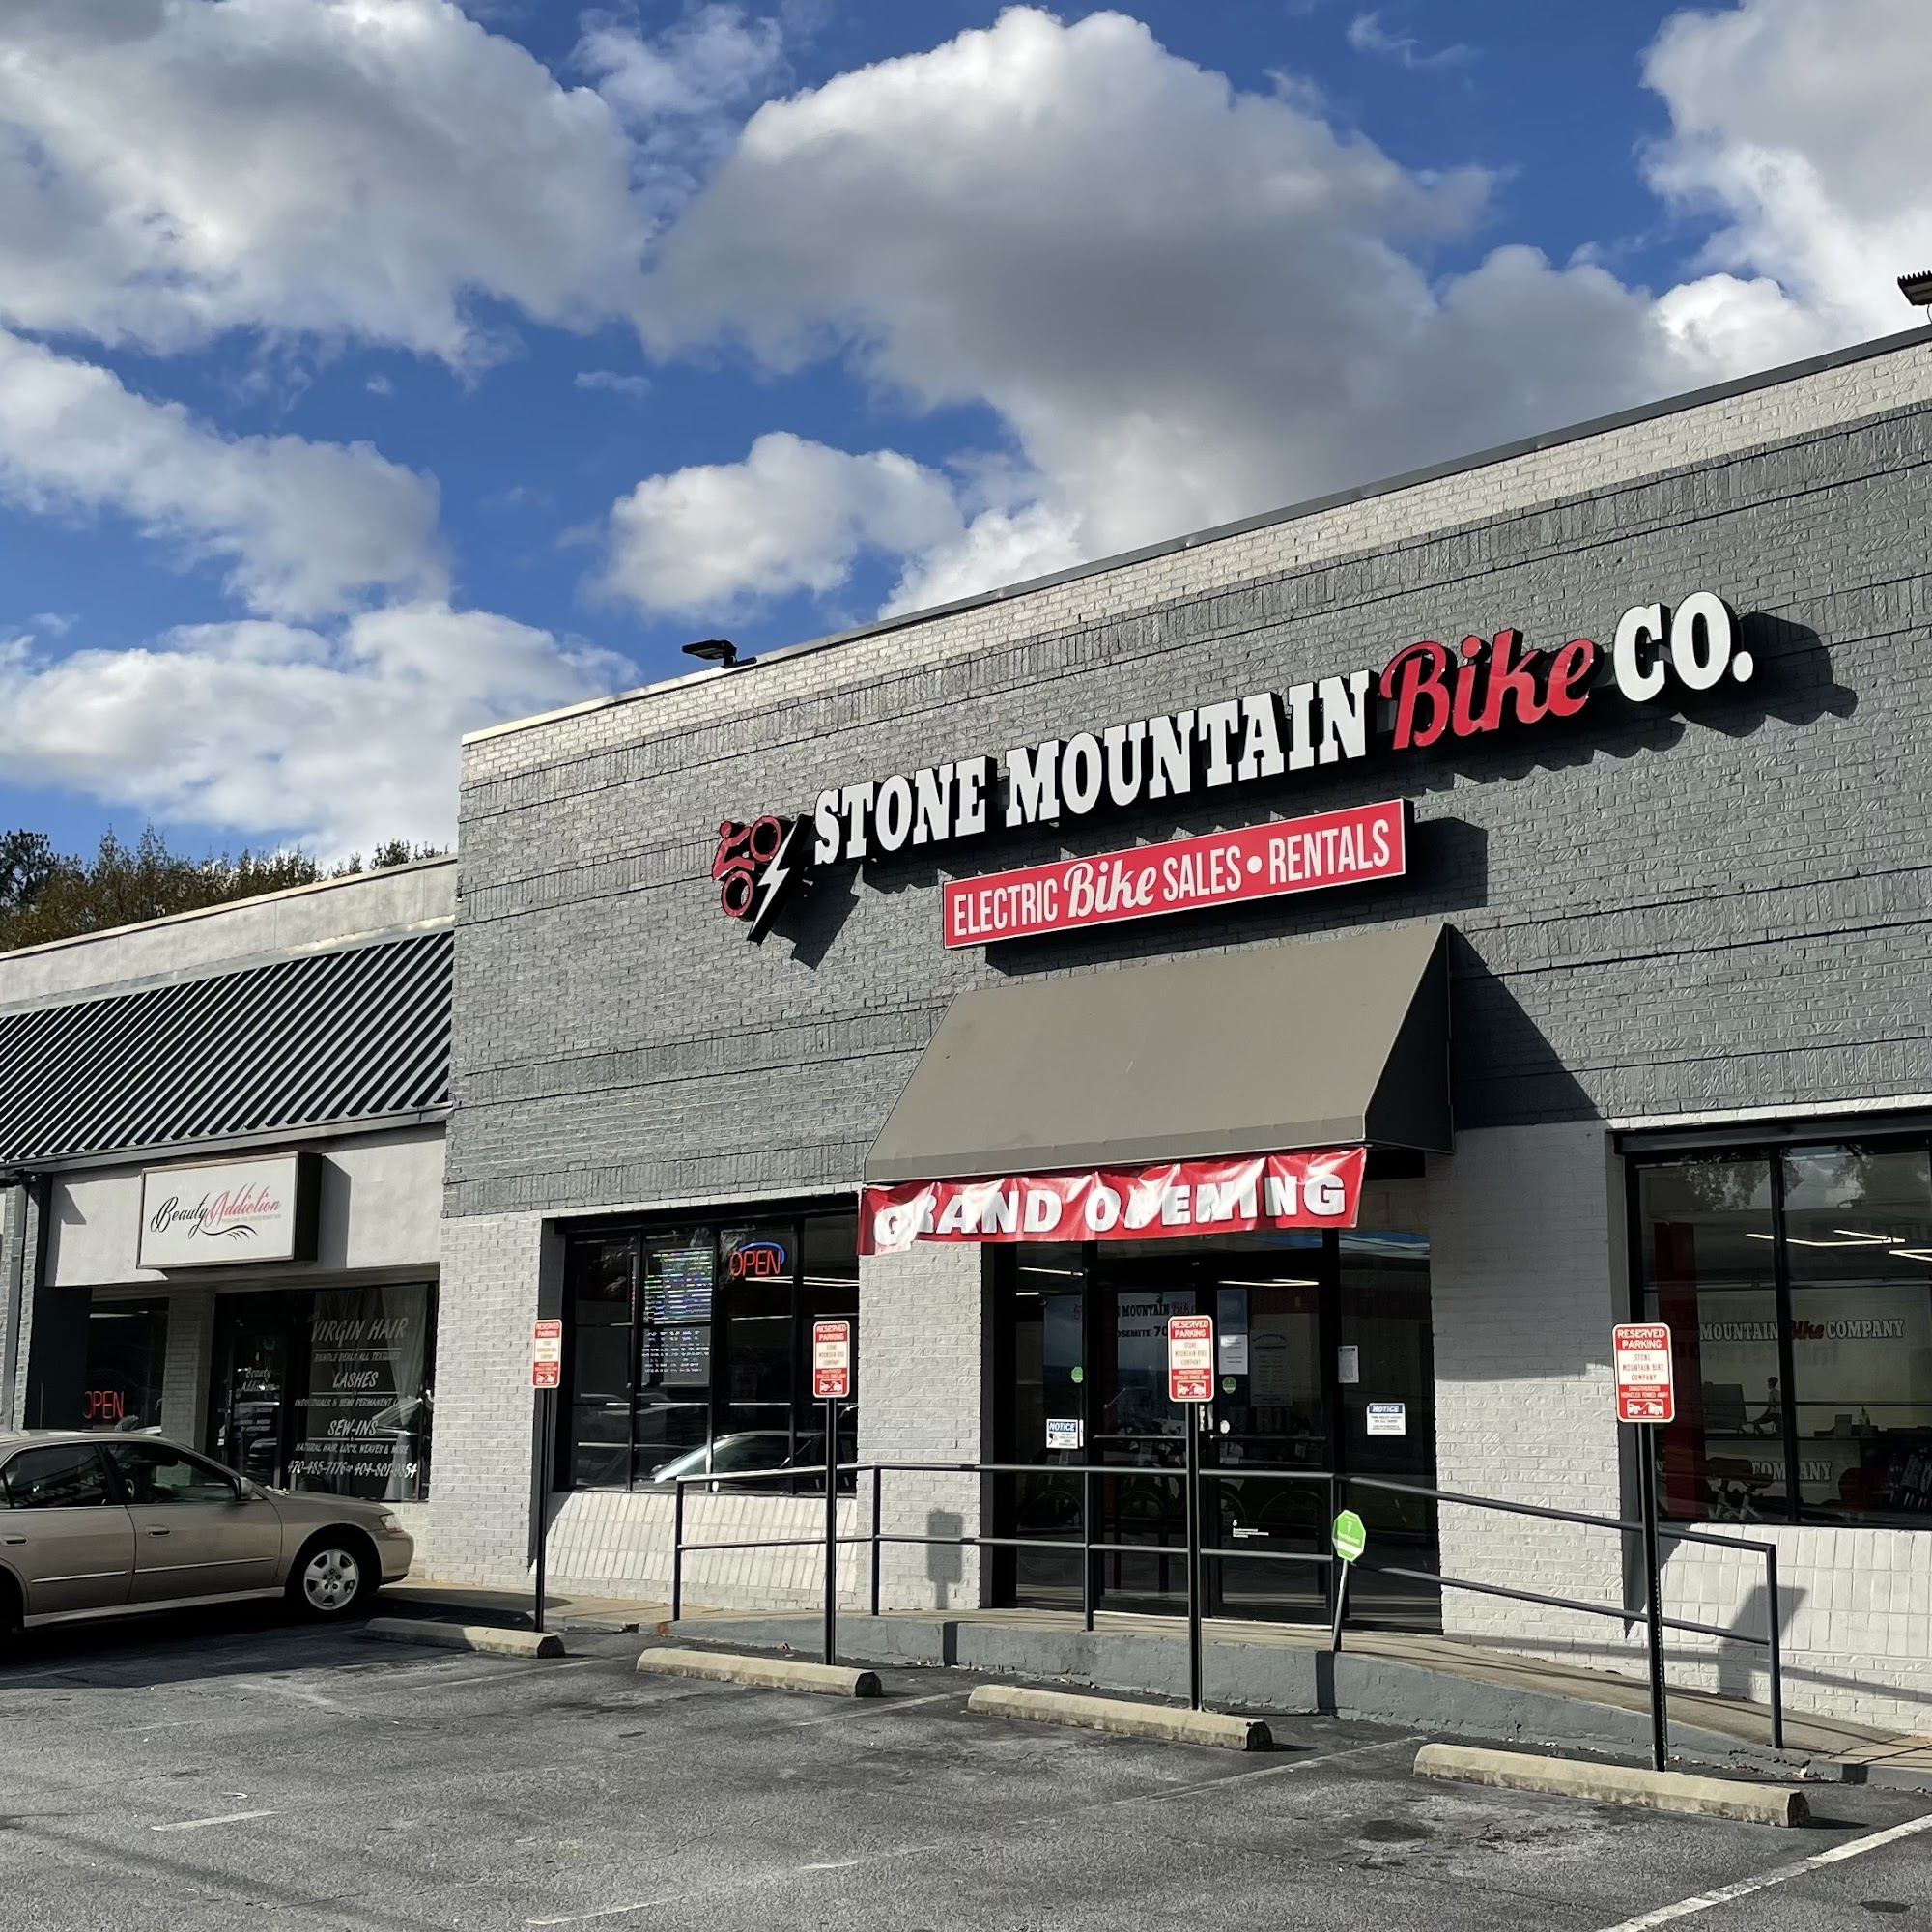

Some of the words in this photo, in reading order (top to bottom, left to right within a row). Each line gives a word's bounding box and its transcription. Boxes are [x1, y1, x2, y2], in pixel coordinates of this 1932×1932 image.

[814, 755, 986, 865] STONE
[1005, 669, 1370, 827] MOUNTAIN
[1379, 628, 1596, 750] Bike
[1613, 590, 1754, 702] CO.
[953, 878, 1058, 937] ELECTRIC
[1063, 859, 1157, 919] Bike
[1162, 845, 1242, 902] SALES
[1268, 819, 1390, 885] RENTALS
[151, 1192, 211, 1239] Beauty
[204, 1182, 280, 1227] Addiction
[873, 1188, 1063, 1246] GRAND
[1084, 1173, 1347, 1233] OPENING
[729, 1249, 781, 1277] OPEN
[1122, 1304, 1170, 1317] MOUNTAIN
[311, 1320, 366, 1348] VIRGIN
[367, 1317, 409, 1340] HAIR
[1171, 1320, 1209, 1329] RESERVED
[1174, 1329, 1206, 1338] PARKING
[1617, 1328, 1665, 1339] RESERVED
[1699, 1321, 1779, 1341] MOUNTAIN
[1826, 1319, 1905, 1339] COMPANY
[1621, 1339, 1662, 1350] PARKING
[332, 1371, 379, 1388] LASHES
[83, 1391, 124, 1419] OPEN
[327, 1418, 378, 1436] SEW-INS
[1049, 1422, 1076, 1432] NOTICE
